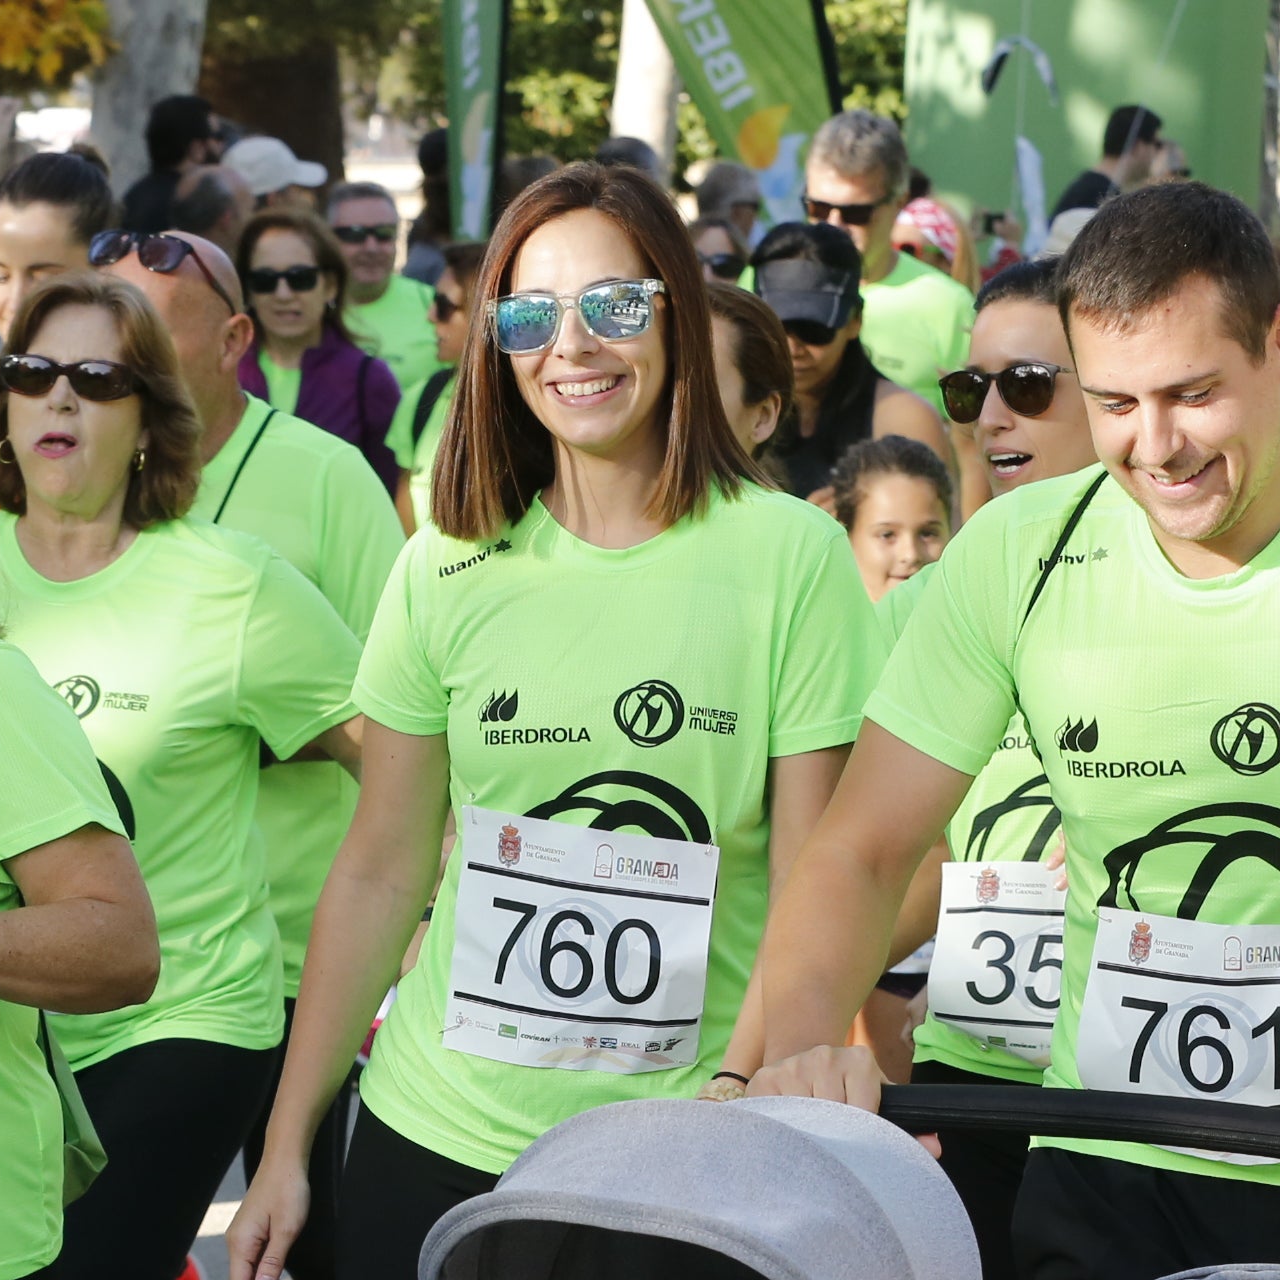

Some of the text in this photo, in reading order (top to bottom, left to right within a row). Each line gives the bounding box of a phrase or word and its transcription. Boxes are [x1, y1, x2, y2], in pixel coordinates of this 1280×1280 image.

[439, 545, 492, 578] luanvi
[103, 699, 147, 711] MUJER
[104, 692, 150, 702] UNIVERSO
[688, 705, 738, 722] UNIVERSO
[688, 717, 736, 736] MUJER
[484, 727, 591, 746] IBERDROLA
[1067, 759, 1186, 778] IBERDROLA
[616, 856, 679, 880] GRANADA
[492, 896, 661, 1005] 760
[966, 930, 1063, 1010] 35
